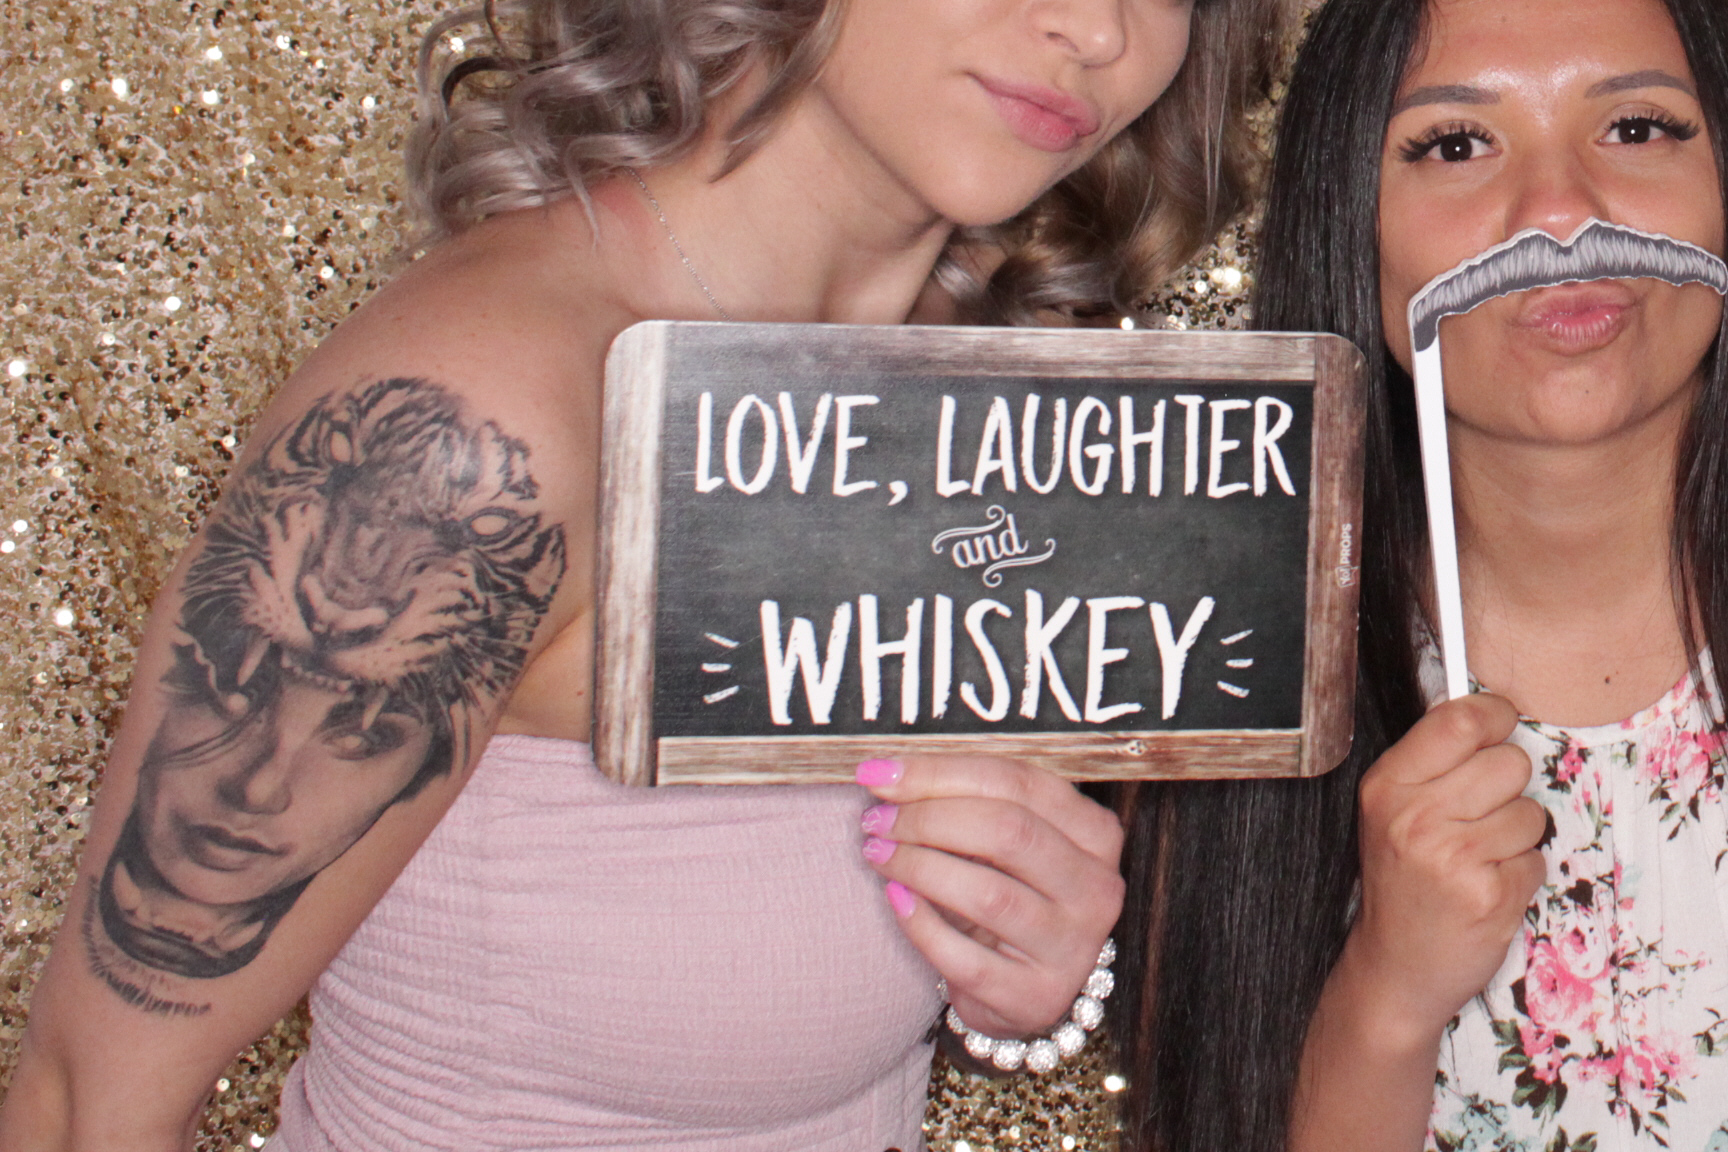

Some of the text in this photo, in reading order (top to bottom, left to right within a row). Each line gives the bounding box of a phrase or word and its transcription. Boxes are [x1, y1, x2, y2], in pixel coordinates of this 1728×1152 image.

[694, 390, 1296, 506] LOVE, LAUGHTER
[951, 512, 1029, 569] and
[1339, 523, 1353, 564] PROPS
[759, 589, 1215, 726] WHISKEY
